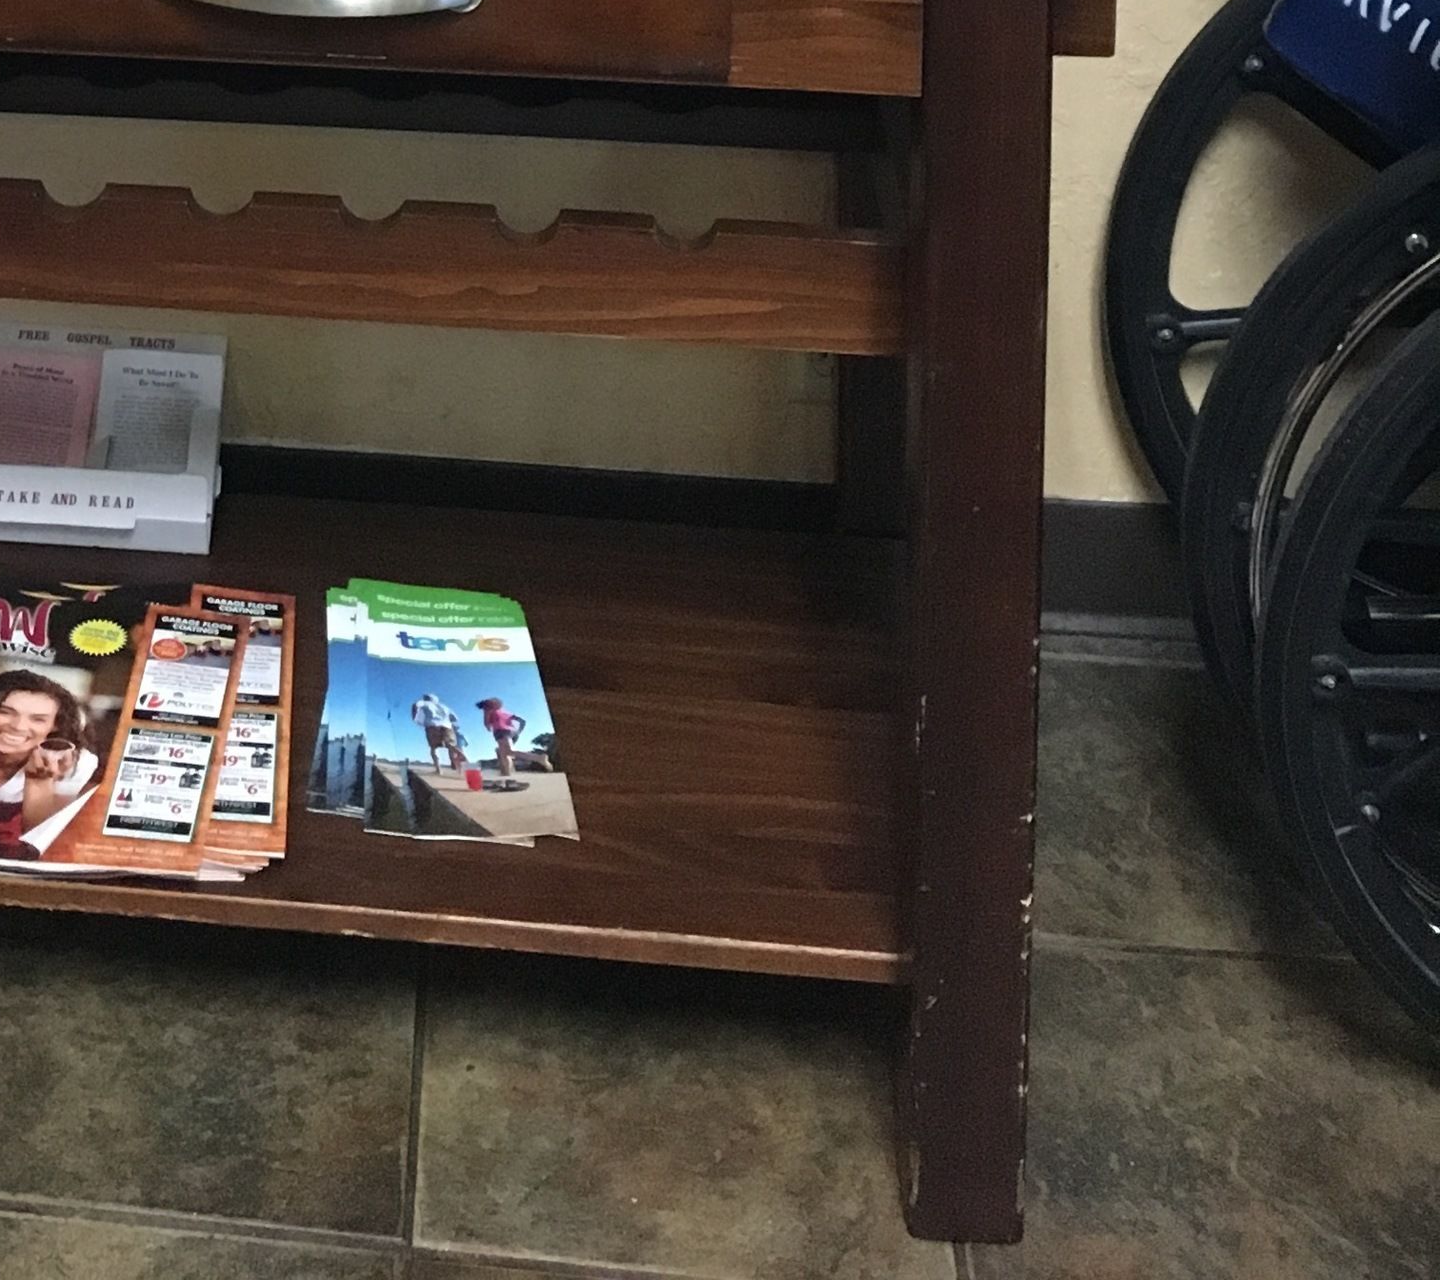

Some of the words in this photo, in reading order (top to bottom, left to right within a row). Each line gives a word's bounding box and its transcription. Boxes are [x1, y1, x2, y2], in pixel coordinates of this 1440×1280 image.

[18, 329, 50, 341] FREE
[66, 332, 112, 345] GOSPEL
[129, 336, 176, 349] TRACTS
[51, 493, 77, 506] AND
[88, 495, 135, 509] READ
[206, 596, 246, 608] GARAGE
[248, 601, 279, 611] FLOOR
[218, 605, 266, 616] COATINGS
[376, 594, 431, 609] special
[433, 600, 471, 611] offer
[161, 615, 201, 627] GARAGE
[203, 620, 233, 631] FLOOR
[381, 611, 435, 623] special
[438, 614, 475, 624] offer
[172, 624, 220, 635] COATINGS
[396, 631, 510, 652] tervis
